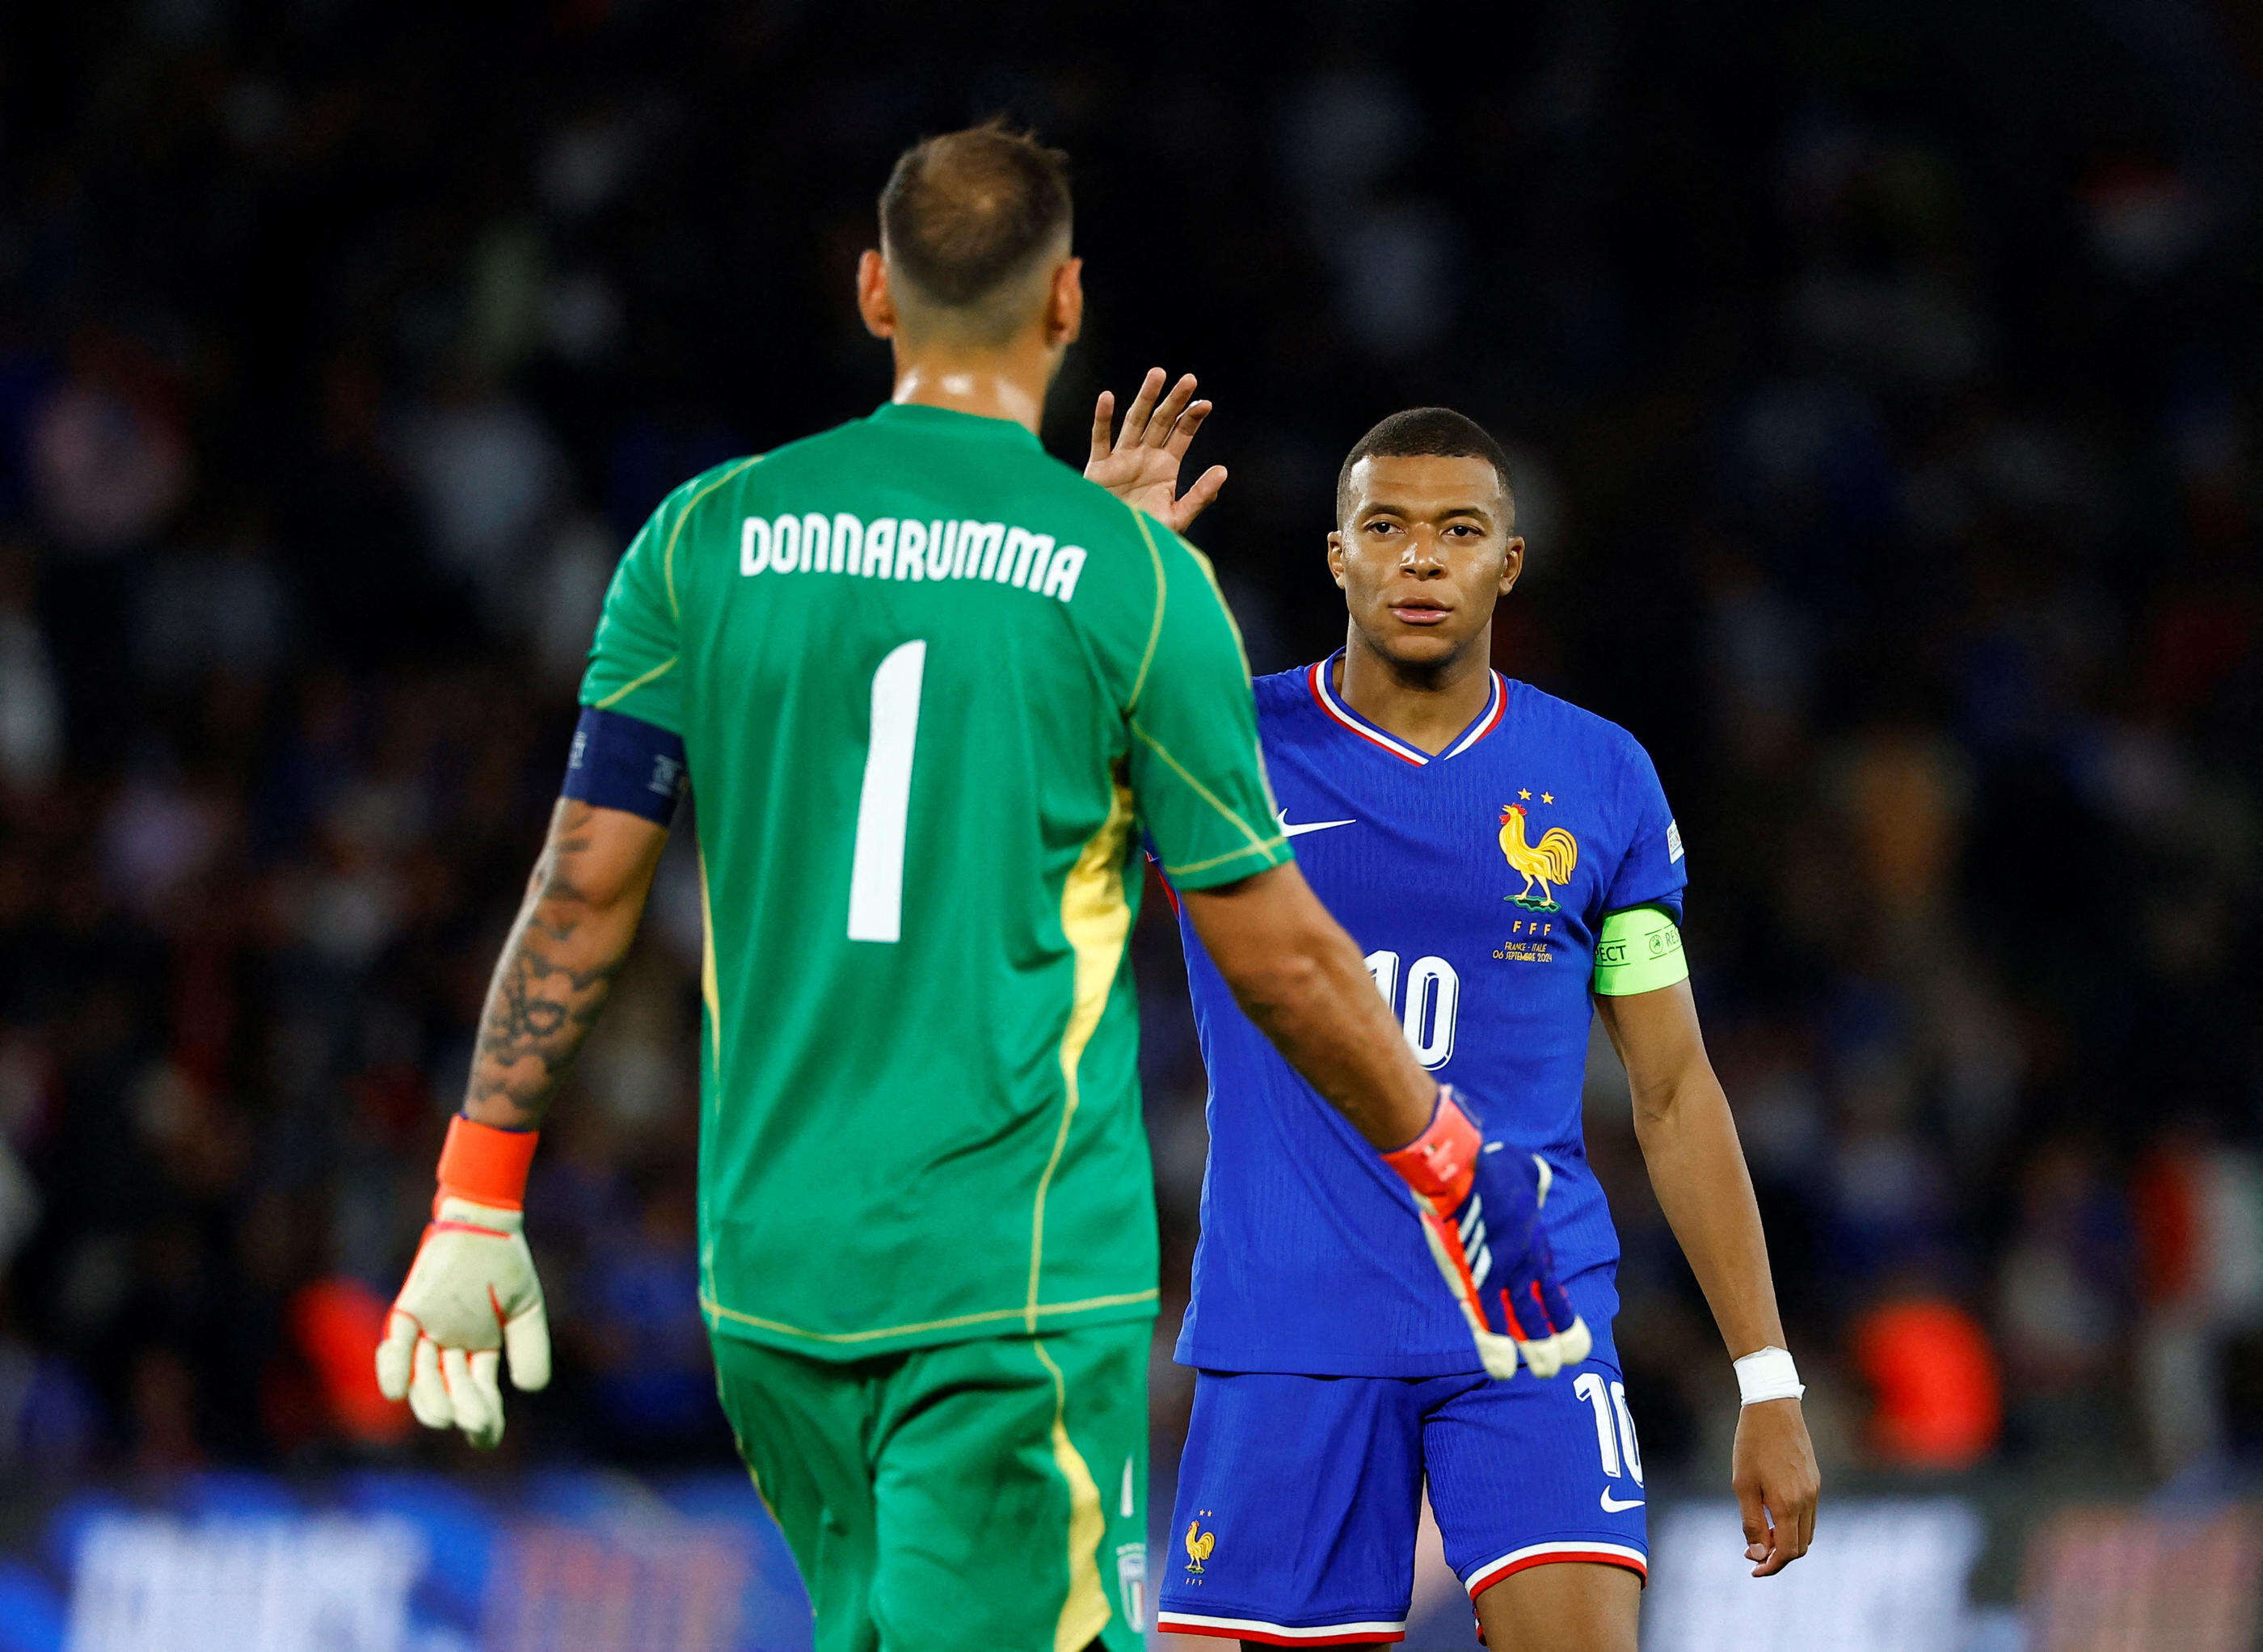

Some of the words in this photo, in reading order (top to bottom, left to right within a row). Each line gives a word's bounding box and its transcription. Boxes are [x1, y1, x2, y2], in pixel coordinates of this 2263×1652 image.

[739, 512, 1089, 604] DONNARUMMA
[847, 639, 925, 943] 1
[1492, 949, 1504, 959] 06
[1505, 950, 1536, 962] SEPTEMBRE
[1536, 952, 1553, 963] 2024
[1504, 941, 1527, 951] FRANCE
